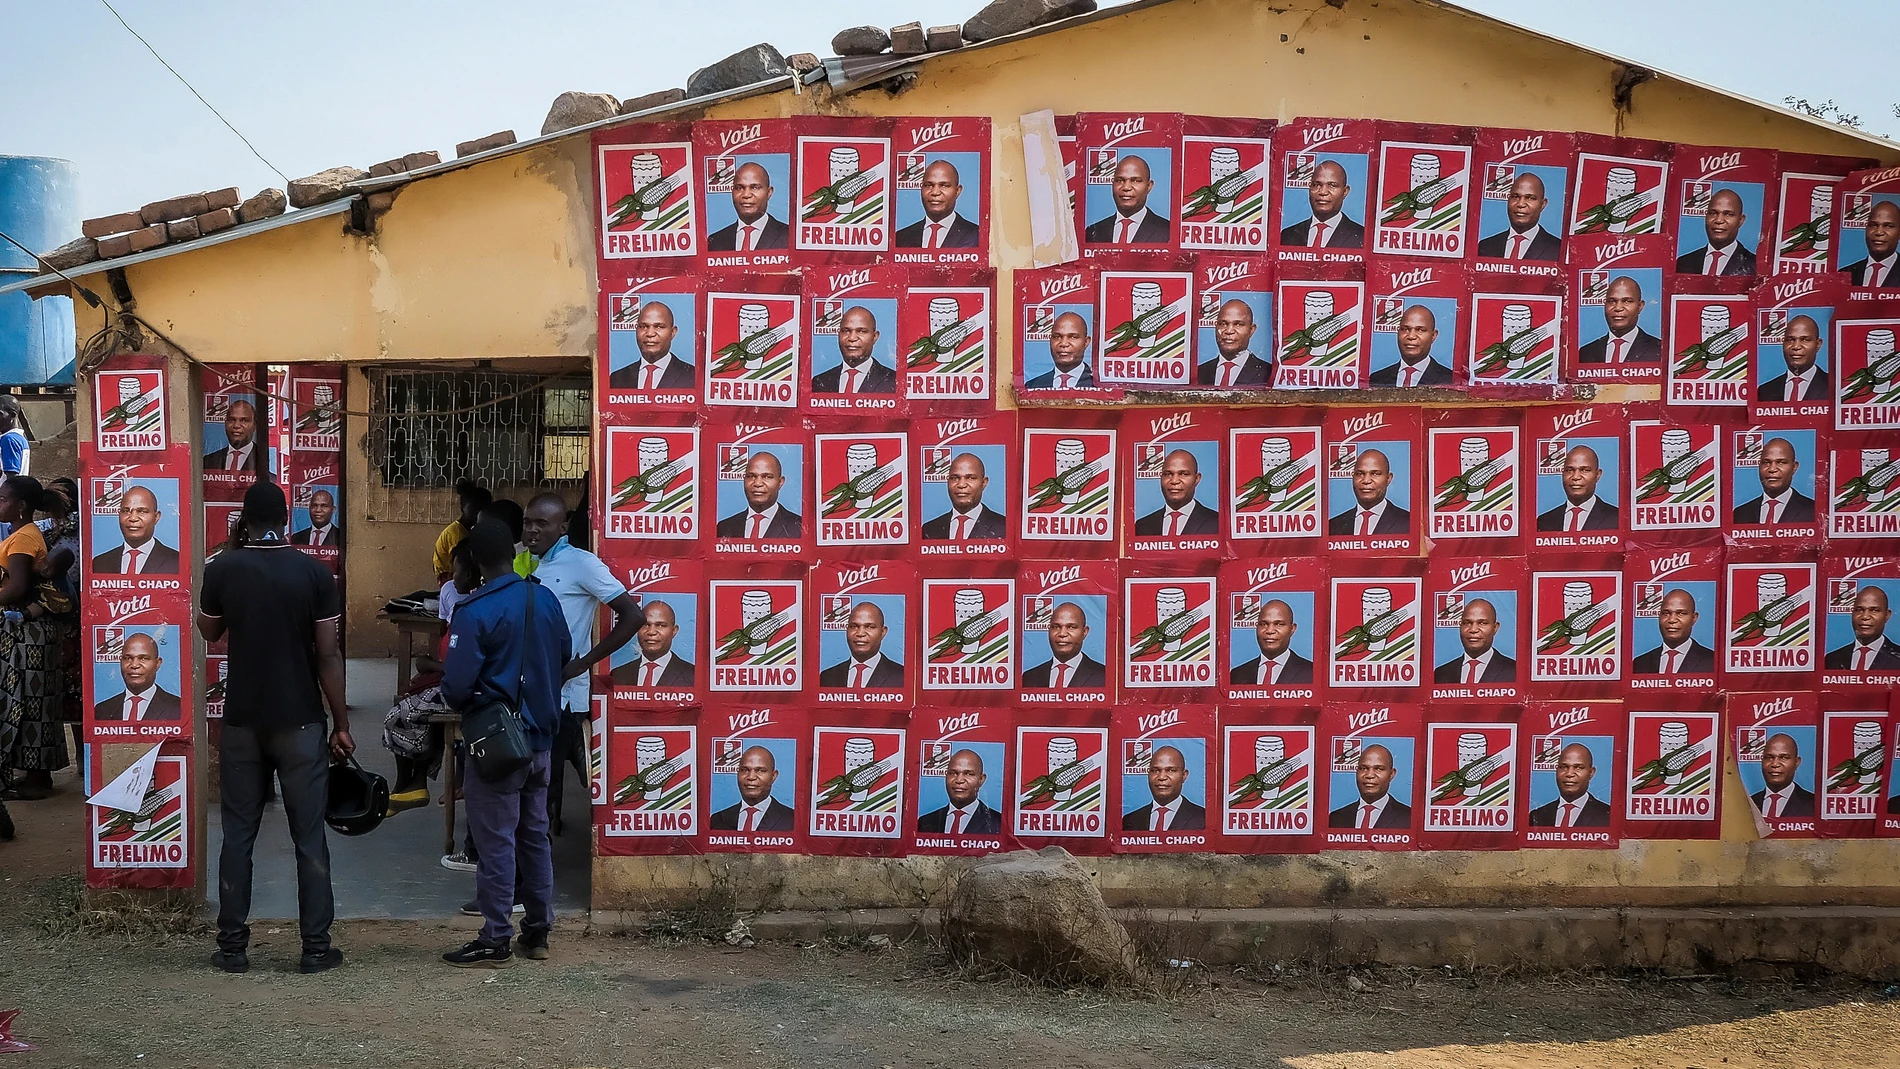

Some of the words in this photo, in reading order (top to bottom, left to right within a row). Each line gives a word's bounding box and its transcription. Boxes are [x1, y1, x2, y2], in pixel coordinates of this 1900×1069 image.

[720, 123, 761, 147] Vota
[911, 121, 952, 145] Vota
[1103, 117, 1144, 140] Vota
[1302, 122, 1343, 145] Vota
[1503, 136, 1543, 156] Vota
[1700, 152, 1741, 171] Vota
[609, 232, 690, 253] FRELIMO
[802, 227, 883, 246] FRELIMO
[1181, 226, 1261, 245] FRELIMO
[1380, 231, 1458, 252] FRELIMO
[895, 254, 936, 263] DANIEL
[940, 253, 978, 262] CHAPO
[1279, 252, 1319, 261] DANIEL
[1323, 253, 1362, 262] CHAPO
[1595, 239, 1635, 261] Vota
[707, 256, 750, 266] DANIEL
[1475, 263, 1516, 274] DANIEL
[1520, 265, 1557, 276] CHAPO
[829, 269, 870, 290] Vota
[1207, 261, 1248, 283] Vota
[1391, 268, 1432, 289] Vota
[1040, 274, 1081, 297] Vota
[1773, 278, 1814, 299] Vota
[217, 370, 252, 387] Vota
[1104, 361, 1184, 379] FRELIMO
[1578, 368, 1618, 378] DANIEL
[1621, 367, 1661, 377] CHAPO
[609, 395, 651, 404] DANIEL
[655, 394, 695, 403] CHAPO
[710, 382, 791, 402] FRELIMO
[810, 399, 852, 408] DANIEL
[855, 399, 895, 408] CHAPO
[1756, 407, 1797, 416] DANIEL
[1150, 412, 1191, 435] Vota
[1343, 413, 1383, 435] Vota
[1553, 409, 1593, 430] Vota
[1841, 406, 1900, 424] FRELIM
[102, 434, 161, 447] FRELIMO
[295, 436, 339, 448] FRELIM
[203, 474, 236, 482] DANIEL
[239, 474, 257, 482] CHA
[303, 466, 330, 479] Vota
[1434, 514, 1513, 532] FRELIMO
[1636, 505, 1714, 524] FRELIMO
[1835, 515, 1900, 532] FRELIM
[611, 515, 692, 533] FRELIMO
[822, 522, 900, 540] FRELIMO
[1027, 517, 1107, 535] FRELIMO
[1236, 515, 1316, 533] FRELIMO
[1536, 537, 1576, 546] DANIEL
[1579, 535, 1618, 545] CHAPO
[1732, 529, 1773, 539] DANIEL
[1775, 528, 1814, 538] CHAPO
[716, 544, 758, 553] DANIEL
[761, 544, 801, 553] CHAPO
[921, 545, 963, 554] DANIEL
[966, 544, 1006, 553] CHAPO
[1135, 541, 1176, 551] DANIEL
[1179, 540, 1218, 549] CHAPO
[1370, 540, 1409, 549] CHAPO
[628, 563, 670, 583] Vota
[1450, 562, 1490, 584] Vota
[1650, 553, 1690, 575] Vota
[837, 565, 878, 586] Vota
[1039, 565, 1080, 587] Vota
[1247, 562, 1287, 585] Vota
[92, 580, 134, 589] DANIEL
[137, 580, 179, 589] CHAPO
[109, 595, 150, 618] Vota
[1537, 658, 1614, 676] FRELIMO
[1731, 649, 1808, 667] FRELIMO
[716, 668, 796, 686] FRELIMO
[928, 667, 1008, 684] FRELIMO
[1131, 664, 1210, 682] FRELIMO
[1335, 663, 1414, 682] FRELIMO
[1823, 676, 1863, 684] DANIEL
[1631, 679, 1672, 688] DANIEL
[1675, 678, 1714, 688] CHAPO
[613, 692, 651, 701] ANIEL
[654, 692, 694, 701] CHAPO
[819, 693, 860, 702] DANIEL
[864, 693, 903, 702] CHAPO
[1021, 693, 1062, 702] DANIEL
[1066, 693, 1105, 702] CHAPO
[1229, 690, 1270, 699] DANIEL
[1274, 690, 1312, 699] CHAPO
[1432, 689, 1473, 698] DANIEL
[1476, 688, 1516, 698] CHAPO
[1753, 697, 1792, 718] Vota
[729, 709, 770, 731] Vota
[938, 712, 979, 734] Vota
[1138, 709, 1179, 731] Vota
[1349, 708, 1389, 729] Vota
[1548, 707, 1588, 728] Vota
[94, 727, 136, 735] DANIEL
[140, 727, 181, 735] CHAPO
[1631, 798, 1709, 815] FRELIMO
[1826, 797, 1876, 815] FRELI
[612, 813, 691, 830] FRELIMO
[816, 814, 896, 832] FRELIMO
[1020, 813, 1099, 831] FRELIMO
[1228, 812, 1307, 829] FRELIMO
[1430, 809, 1508, 826] FRELIMO
[709, 836, 750, 845] DANIEL
[754, 837, 793, 845] CHAPO
[916, 838, 957, 848] DANIEL
[961, 839, 1000, 849] CHAPO
[1122, 836, 1163, 845] DANIEL
[1166, 835, 1205, 844] CHAPO
[1328, 834, 1367, 843] DANIEL
[1370, 834, 1409, 843] CHAPO
[1527, 832, 1567, 841] DANIEL
[1571, 833, 1609, 841] CHAPO
[99, 845, 181, 863] FRELIMO
